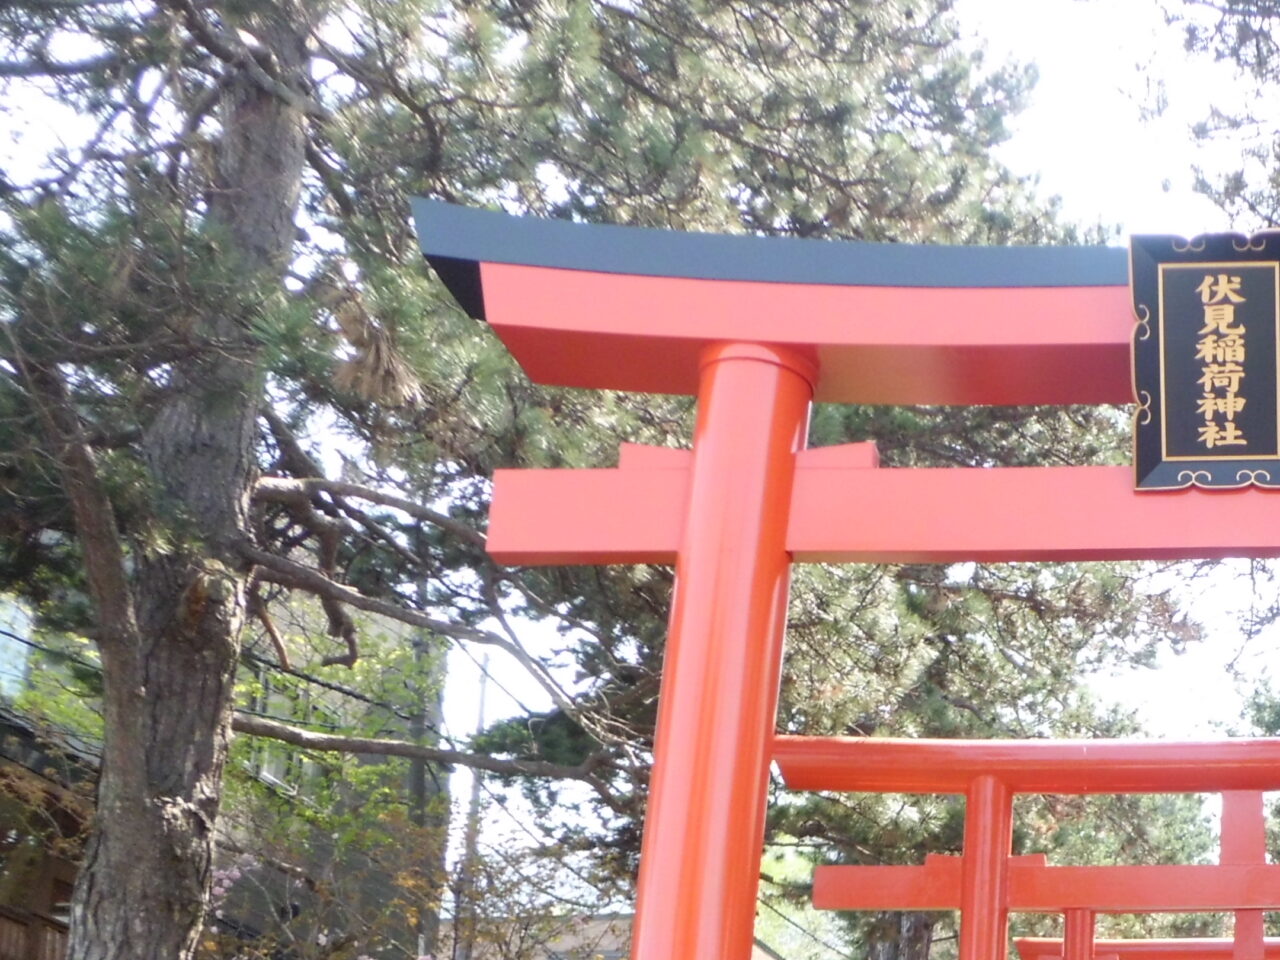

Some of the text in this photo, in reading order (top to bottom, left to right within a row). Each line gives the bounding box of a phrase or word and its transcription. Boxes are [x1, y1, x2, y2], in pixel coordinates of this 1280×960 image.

[1194, 273, 1248, 449] 伏見稲荷神社
